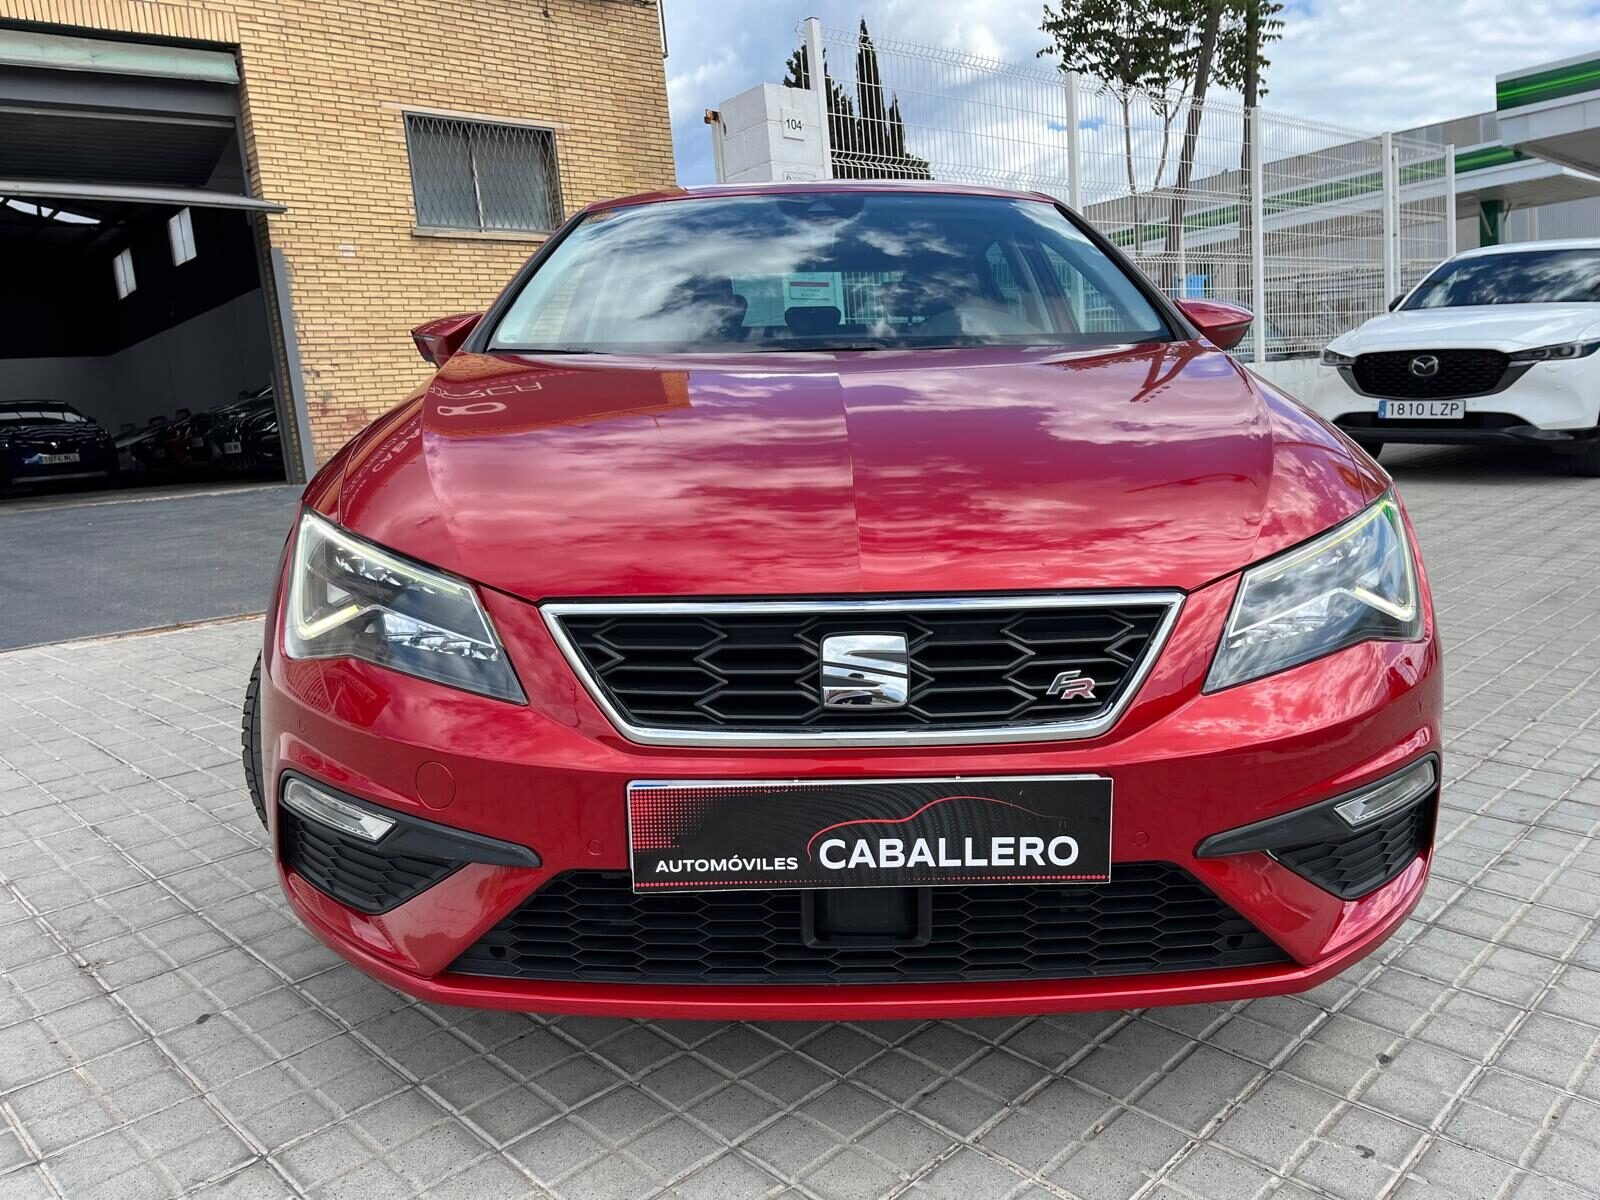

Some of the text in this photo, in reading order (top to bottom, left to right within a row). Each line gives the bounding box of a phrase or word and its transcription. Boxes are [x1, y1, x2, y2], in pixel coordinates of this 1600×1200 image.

[786, 118, 802, 130] 104
[1390, 402, 1460, 416] 1810 LZP
[1045, 669, 1097, 700] FR
[655, 835, 1079, 873] AUTOMÓVILES CABALLERO
